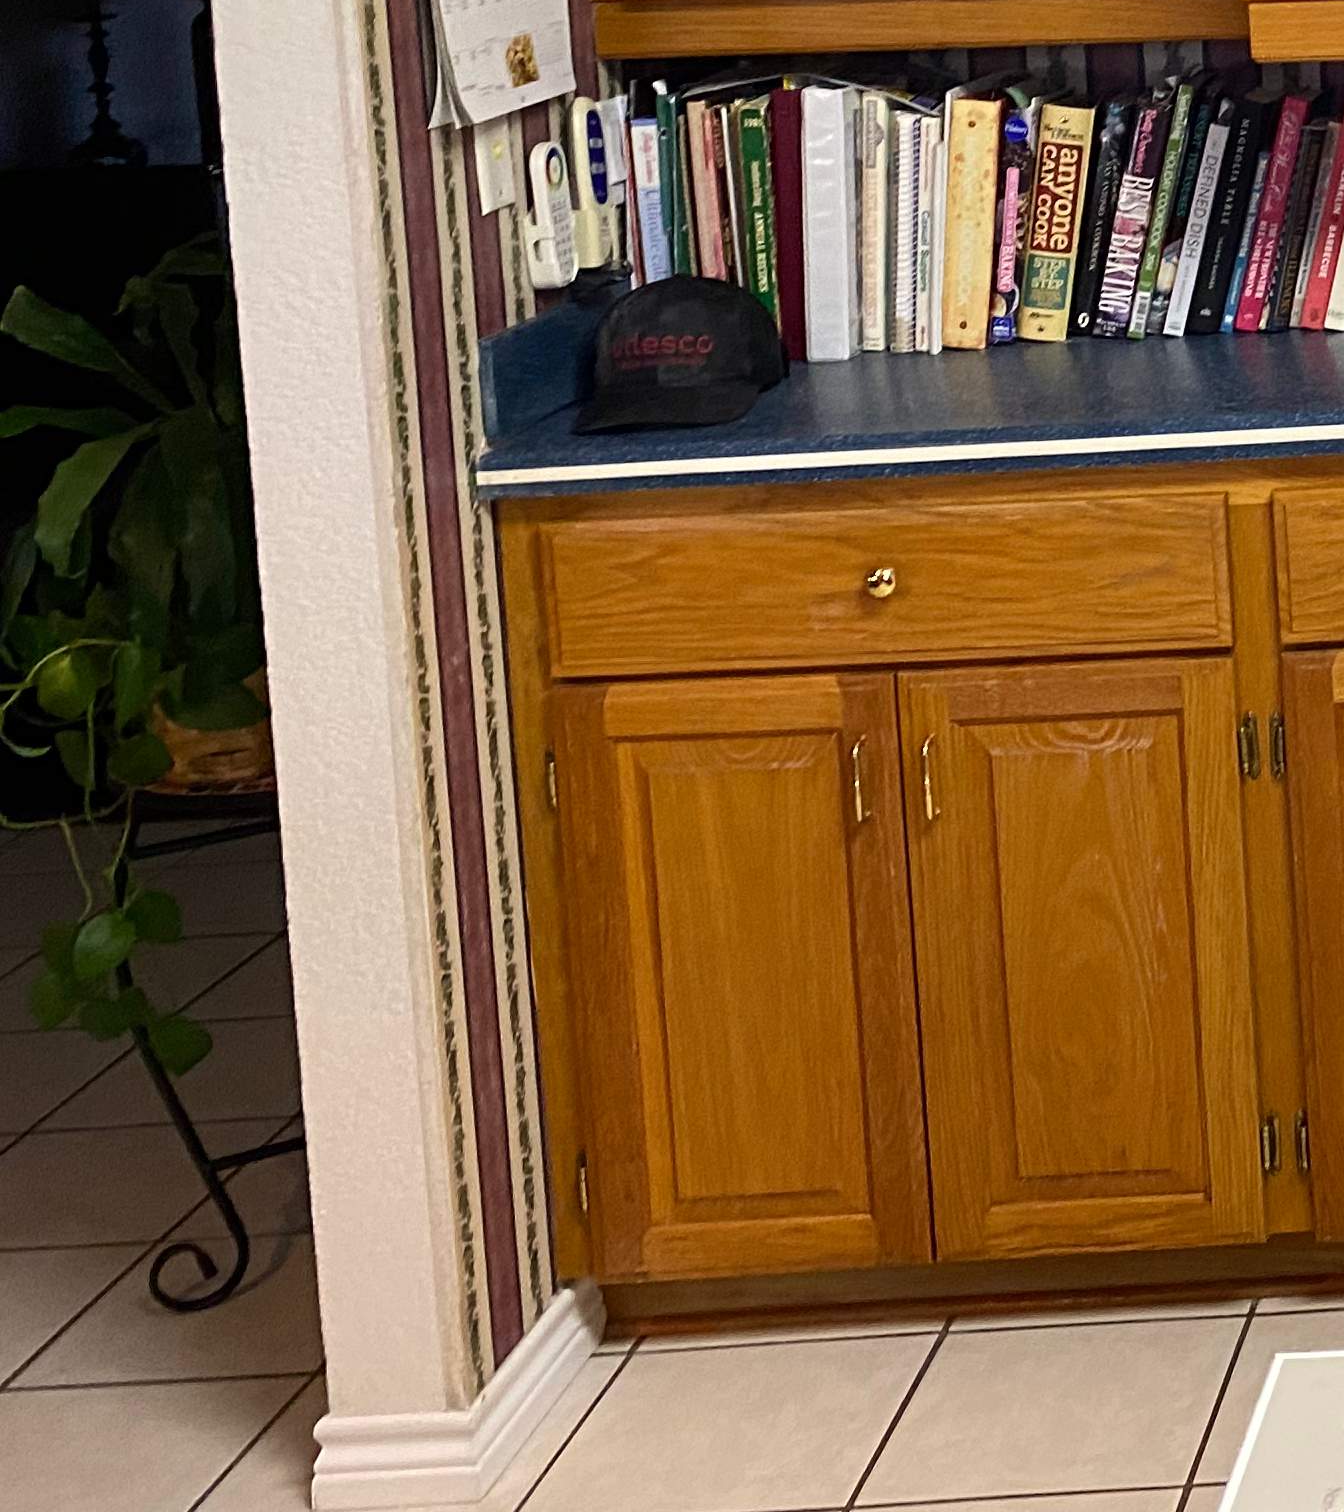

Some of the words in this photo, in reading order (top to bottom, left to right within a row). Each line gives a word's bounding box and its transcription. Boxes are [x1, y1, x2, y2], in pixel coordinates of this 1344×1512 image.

[1040, 145, 1057, 187] CAN
[1229, 118, 1251, 184] MAGNOLIA
[1045, 147, 1079, 250] anyone
[1116, 174, 1156, 226] BEST
[1191, 155, 1219, 219] DEFINED
[1219, 188, 1237, 226] TABLE
[754, 212, 767, 250] ANNUAL
[921, 210, 930, 246] Casual
[1032, 194, 1052, 248] COOK
[1184, 222, 1204, 260] DISH
[757, 252, 769, 293] RECIPES
[998, 244, 1015, 291] BAKING
[1098, 232, 1142, 313] BAKING
[1318, 225, 1338, 279] BARBECUE
